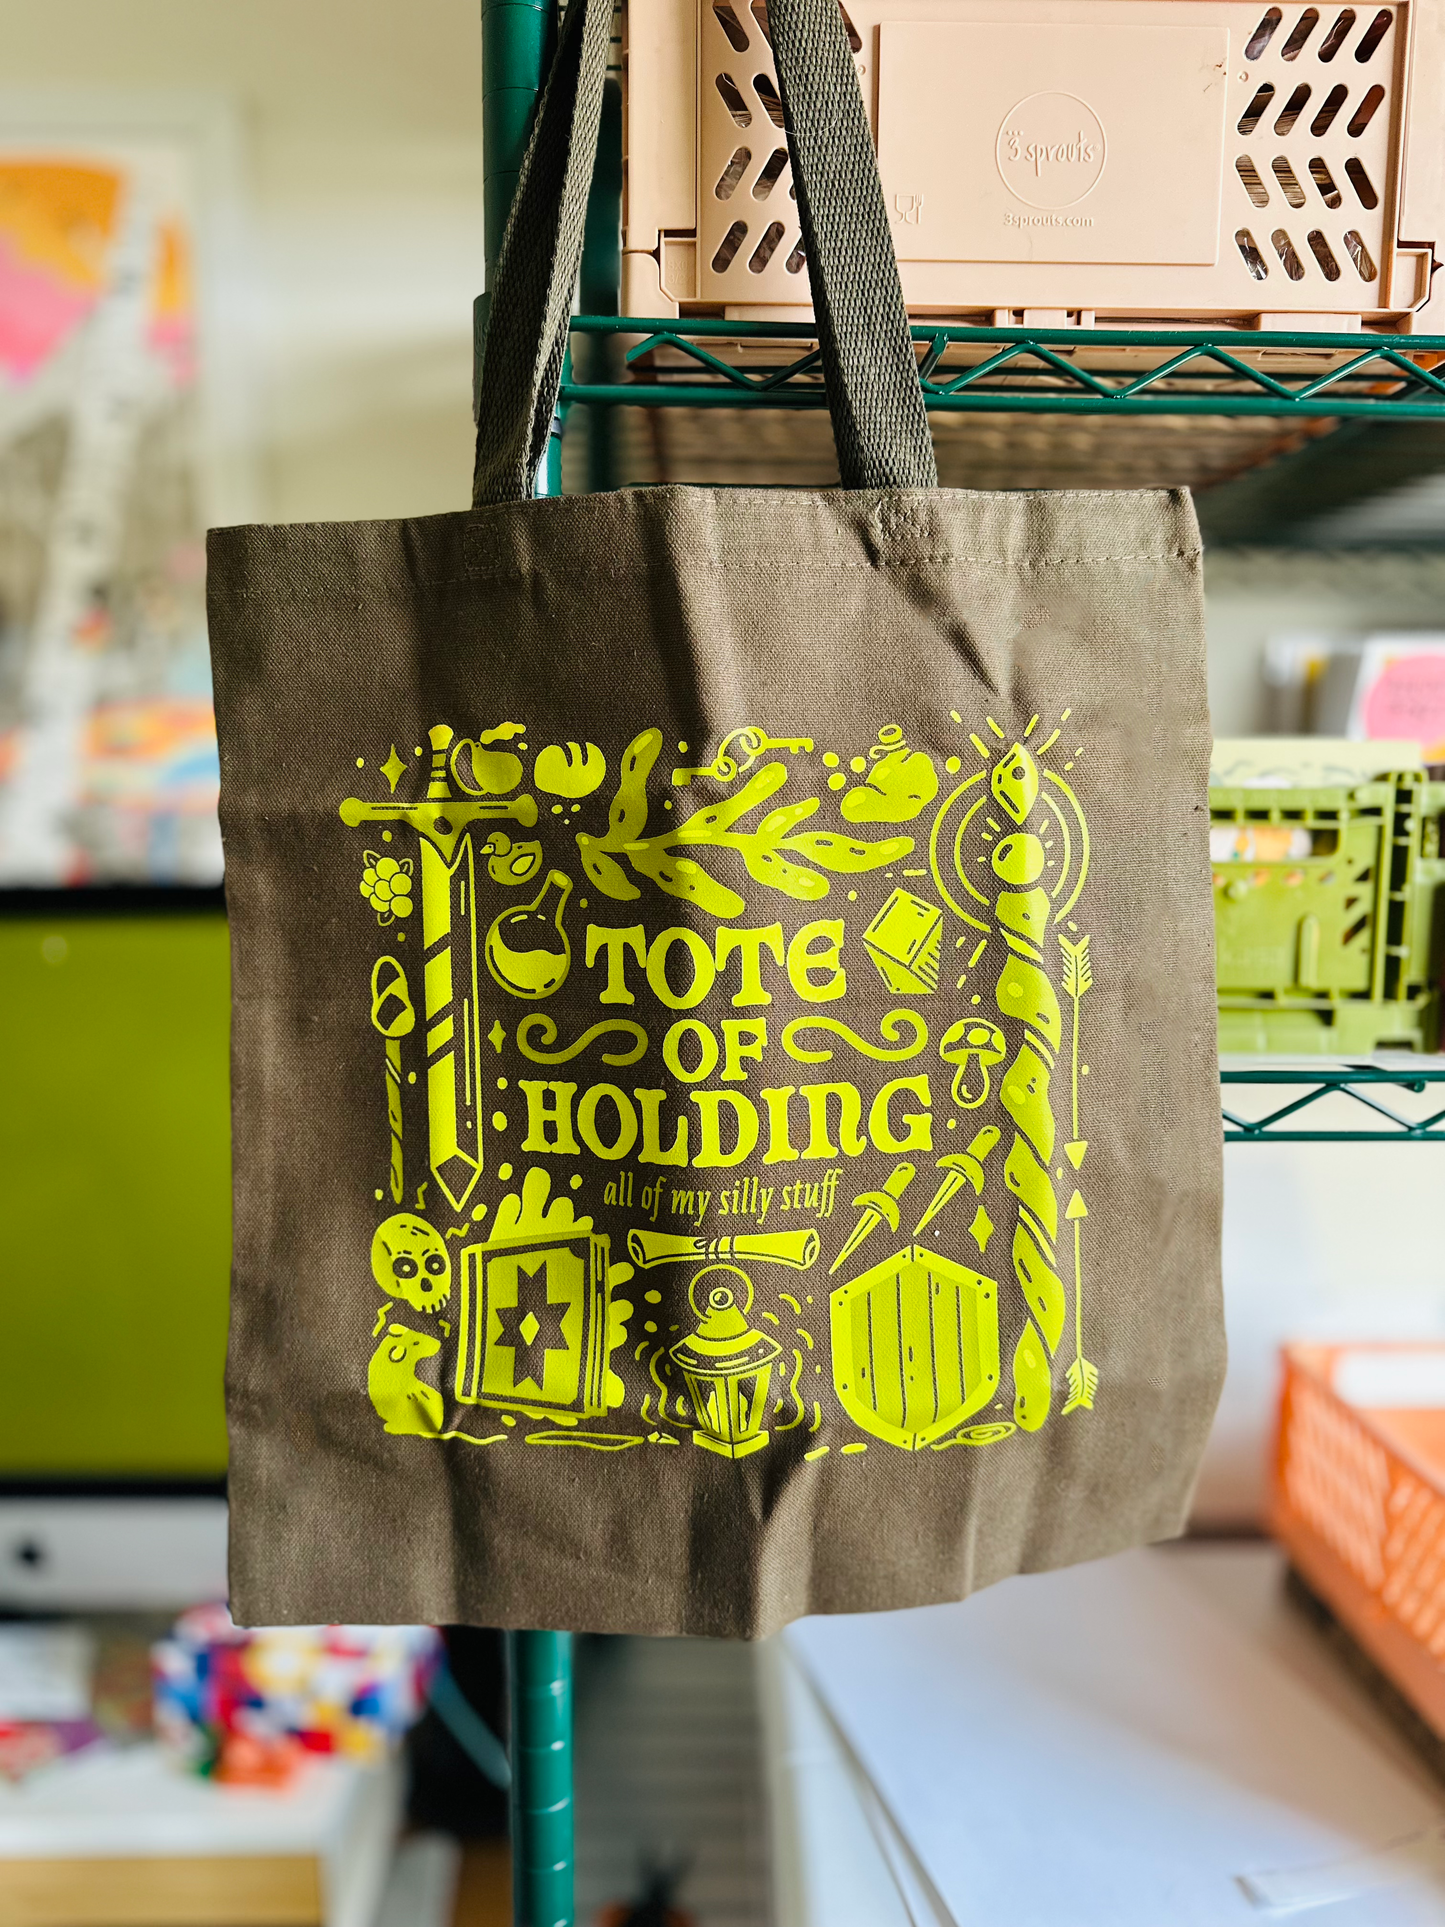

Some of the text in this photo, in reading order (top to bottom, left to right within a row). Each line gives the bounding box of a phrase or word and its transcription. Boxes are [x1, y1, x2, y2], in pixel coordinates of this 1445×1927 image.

[1006, 129, 1094, 177] 3 sprouts
[1003, 213, 1094, 229] 3sprouts.com
[585, 919, 847, 1010] TOTE
[662, 1016, 768, 1083] OF
[518, 1074, 934, 1168] HOLDING
[603, 1168, 843, 1227] all of my silly stuff
